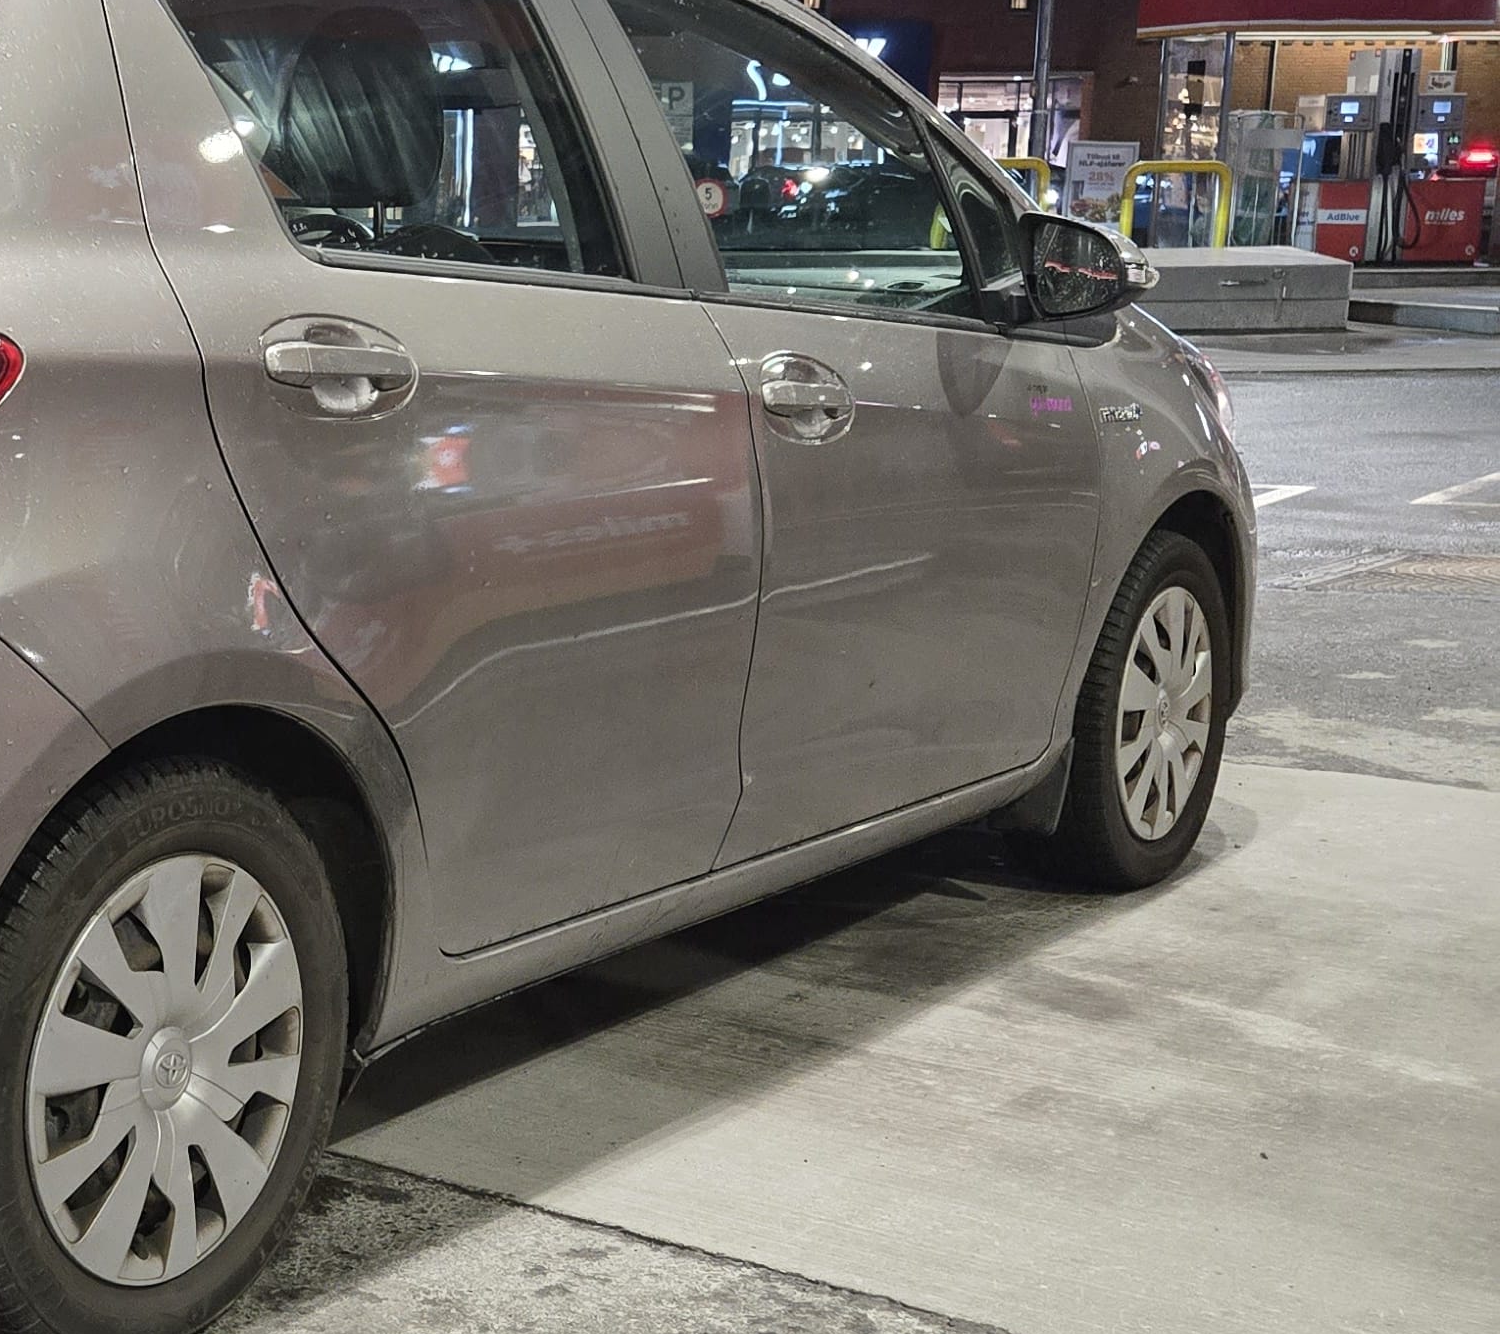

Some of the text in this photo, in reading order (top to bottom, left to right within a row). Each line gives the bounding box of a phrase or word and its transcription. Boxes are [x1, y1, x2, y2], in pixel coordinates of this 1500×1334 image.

[668, 86, 686, 110] P
[704, 187, 713, 201] 5
[1326, 212, 1360, 222] AdBlue
[1424, 208, 1465, 222] miles
